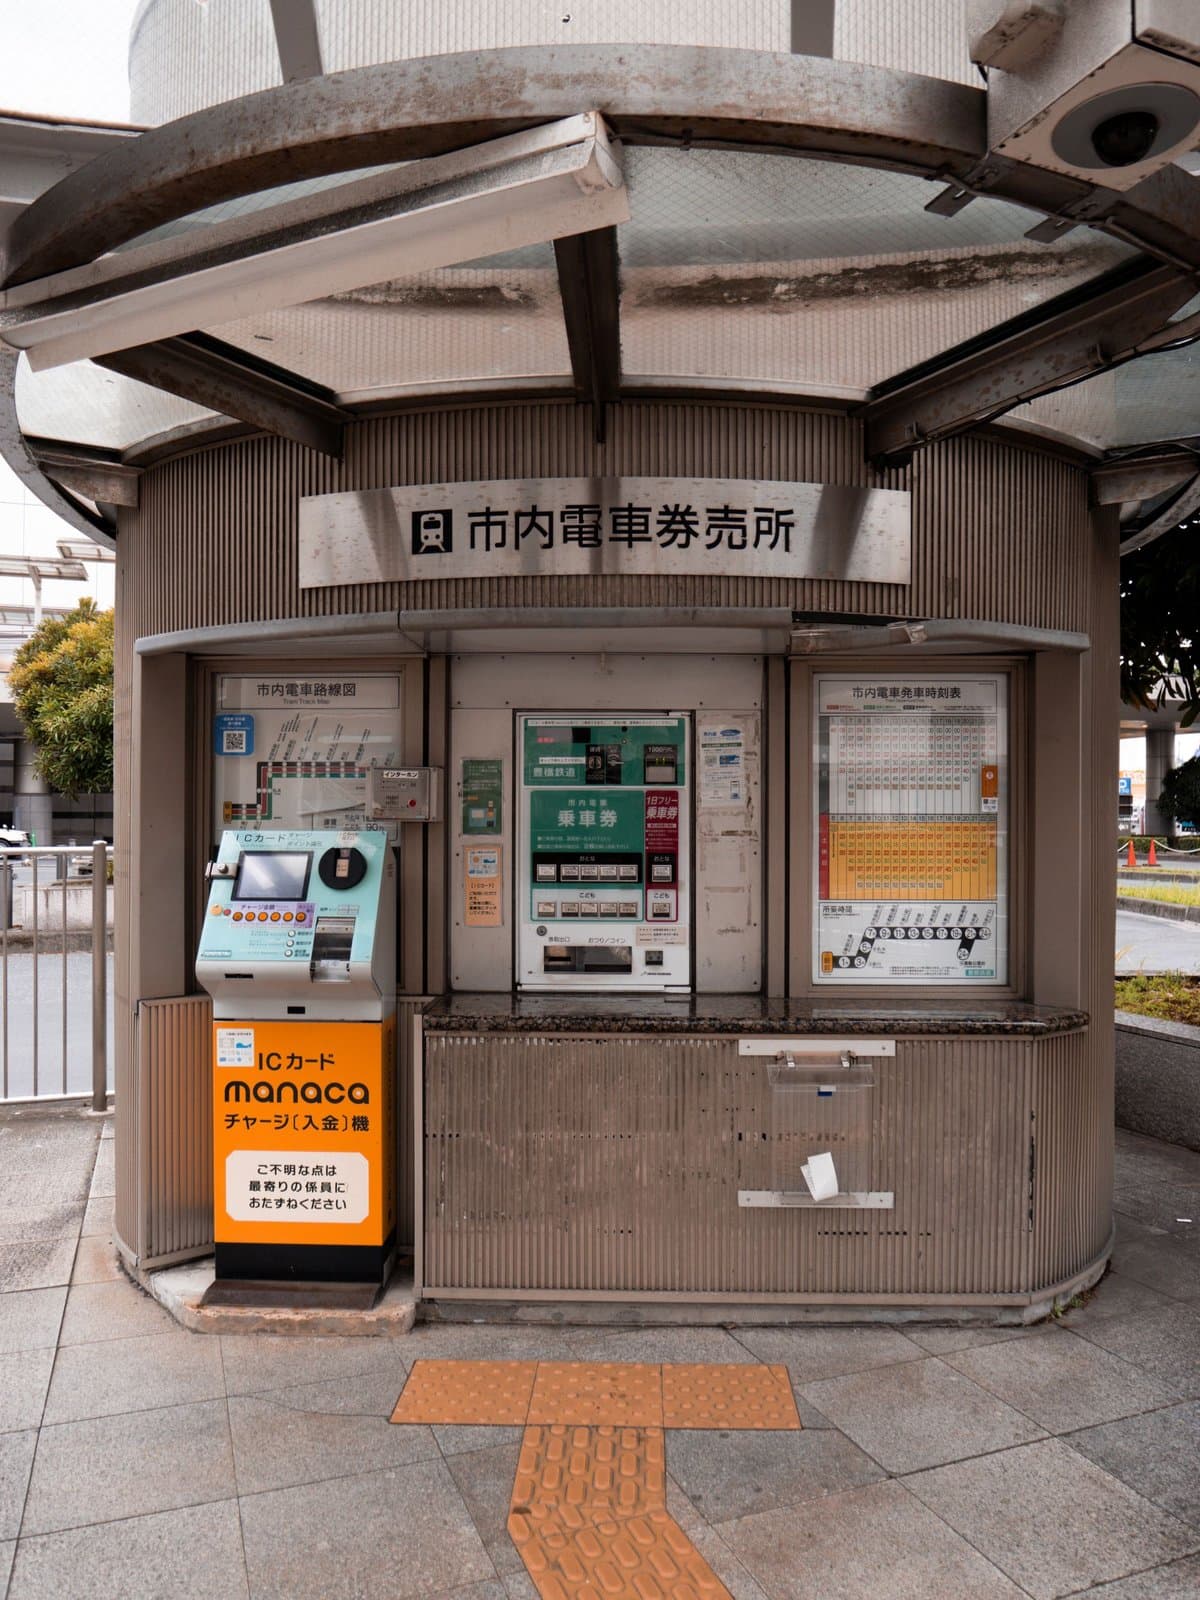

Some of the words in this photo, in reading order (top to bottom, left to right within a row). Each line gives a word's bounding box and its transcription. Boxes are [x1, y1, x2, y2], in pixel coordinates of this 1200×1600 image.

[468, 502, 796, 553] 市内電車券売所
[257, 682, 356, 697] 市内電車路線図
[852, 687, 962, 699] 市内電車発車時刻表
[558, 809, 618, 828] 乗車券
[646, 806, 679, 819] 乗車券
[258, 1052, 335, 1071] ICカード
[224, 1081, 369, 1104] manaca
[257, 1164, 337, 1177] ご不明な点は
[249, 1180, 346, 1194] 最寄りの係員に
[249, 1197, 347, 1210] おたずねください
